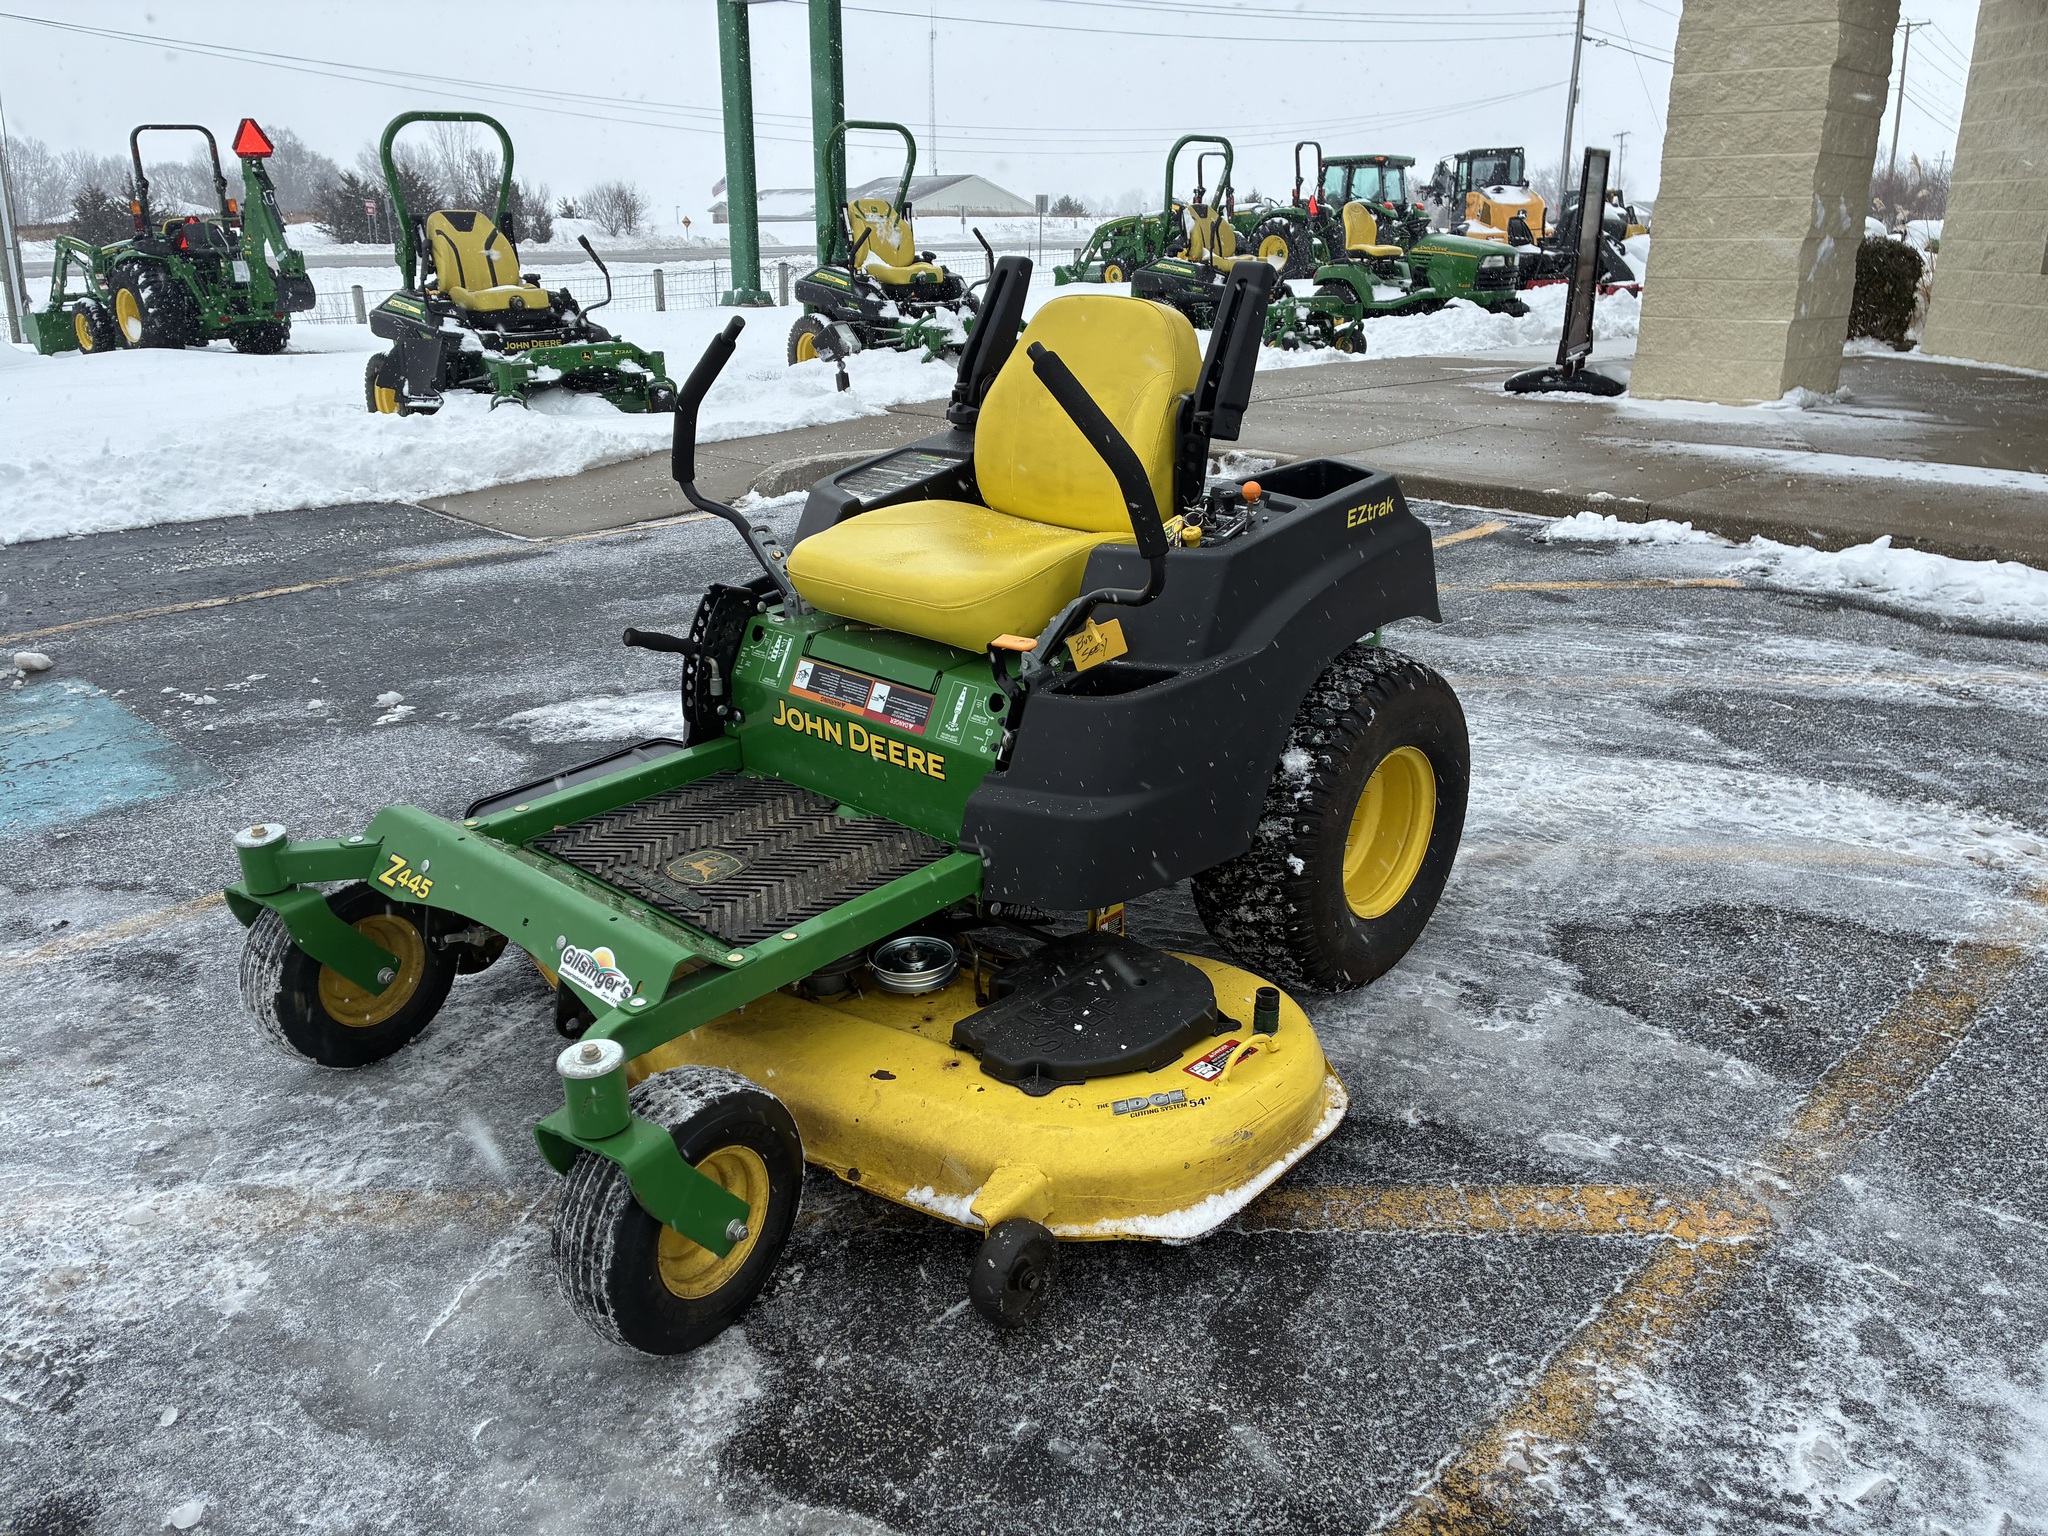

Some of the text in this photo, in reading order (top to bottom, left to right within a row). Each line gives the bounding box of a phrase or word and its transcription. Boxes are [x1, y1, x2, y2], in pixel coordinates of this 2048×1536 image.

[504, 339, 562, 350] JOHN DEERE
[1347, 495, 1394, 529] EZtrak
[773, 699, 946, 781] JOHN DEERE
[889, 717, 911, 729] DANGER
[377, 852, 434, 899] Z445
[562, 947, 632, 999] Gilsinger's
[1028, 998, 1118, 1054] STEP
[1096, 1088, 1187, 1116] THE EDGE
[1130, 1096, 1212, 1118] CUTTING SYSTEM 54"
